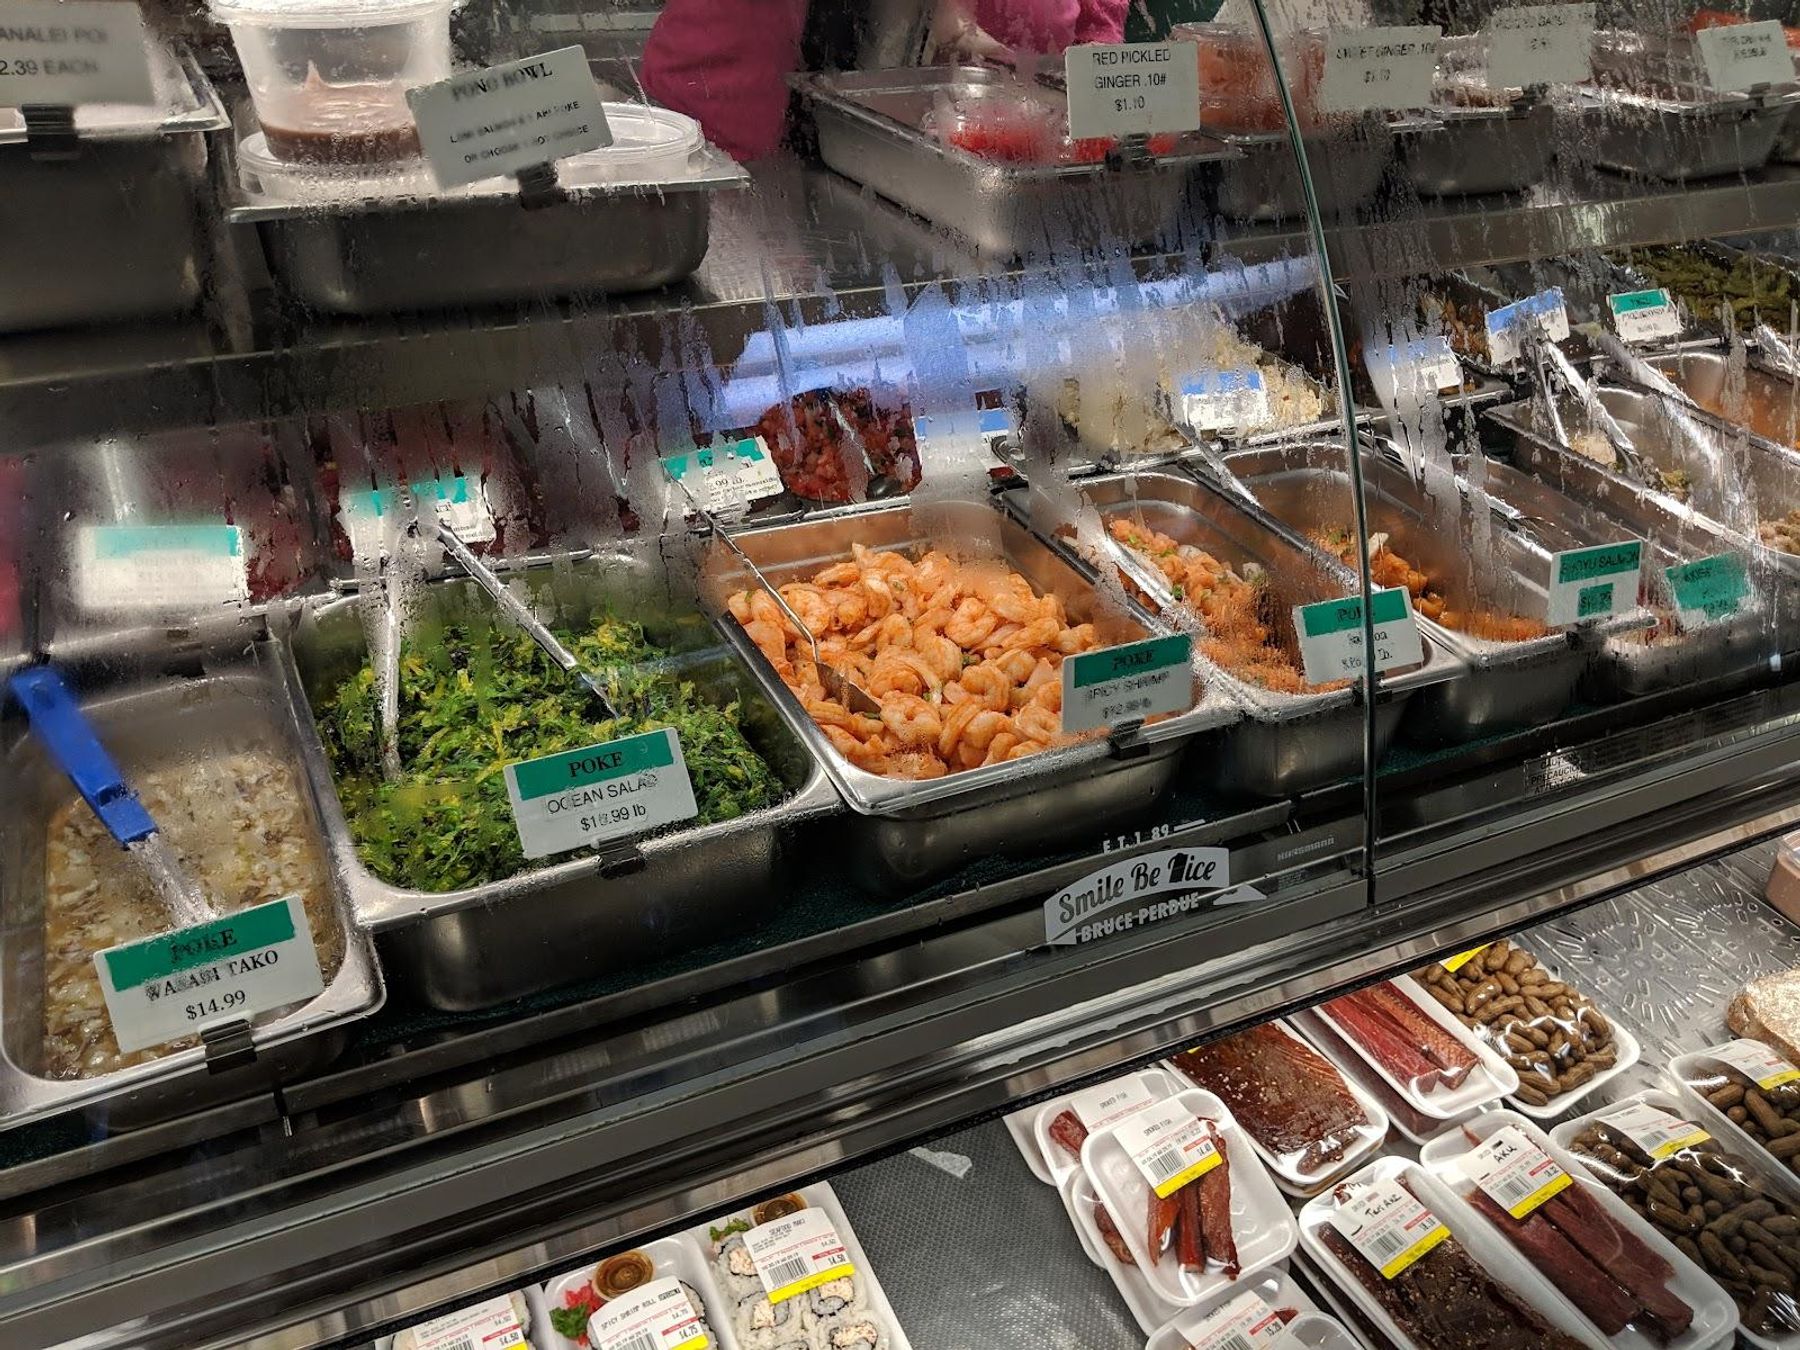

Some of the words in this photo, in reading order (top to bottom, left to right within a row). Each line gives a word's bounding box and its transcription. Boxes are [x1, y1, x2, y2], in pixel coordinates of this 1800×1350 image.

[1092, 52, 1118, 65] RED
[1121, 49, 1171, 64] PICKLED
[1095, 74, 1141, 89] GINGER
[568, 752, 623, 778] POKE
[547, 787, 603, 815] OCEAN
[1058, 873, 1125, 925] Smile
[1130, 861, 1161, 892] Be
[1081, 911, 1134, 943] BRUCE
[1138, 890, 1200, 926] PERDUE
[229, 949, 279, 977] TAKO
[185, 990, 247, 1021] $14.99
